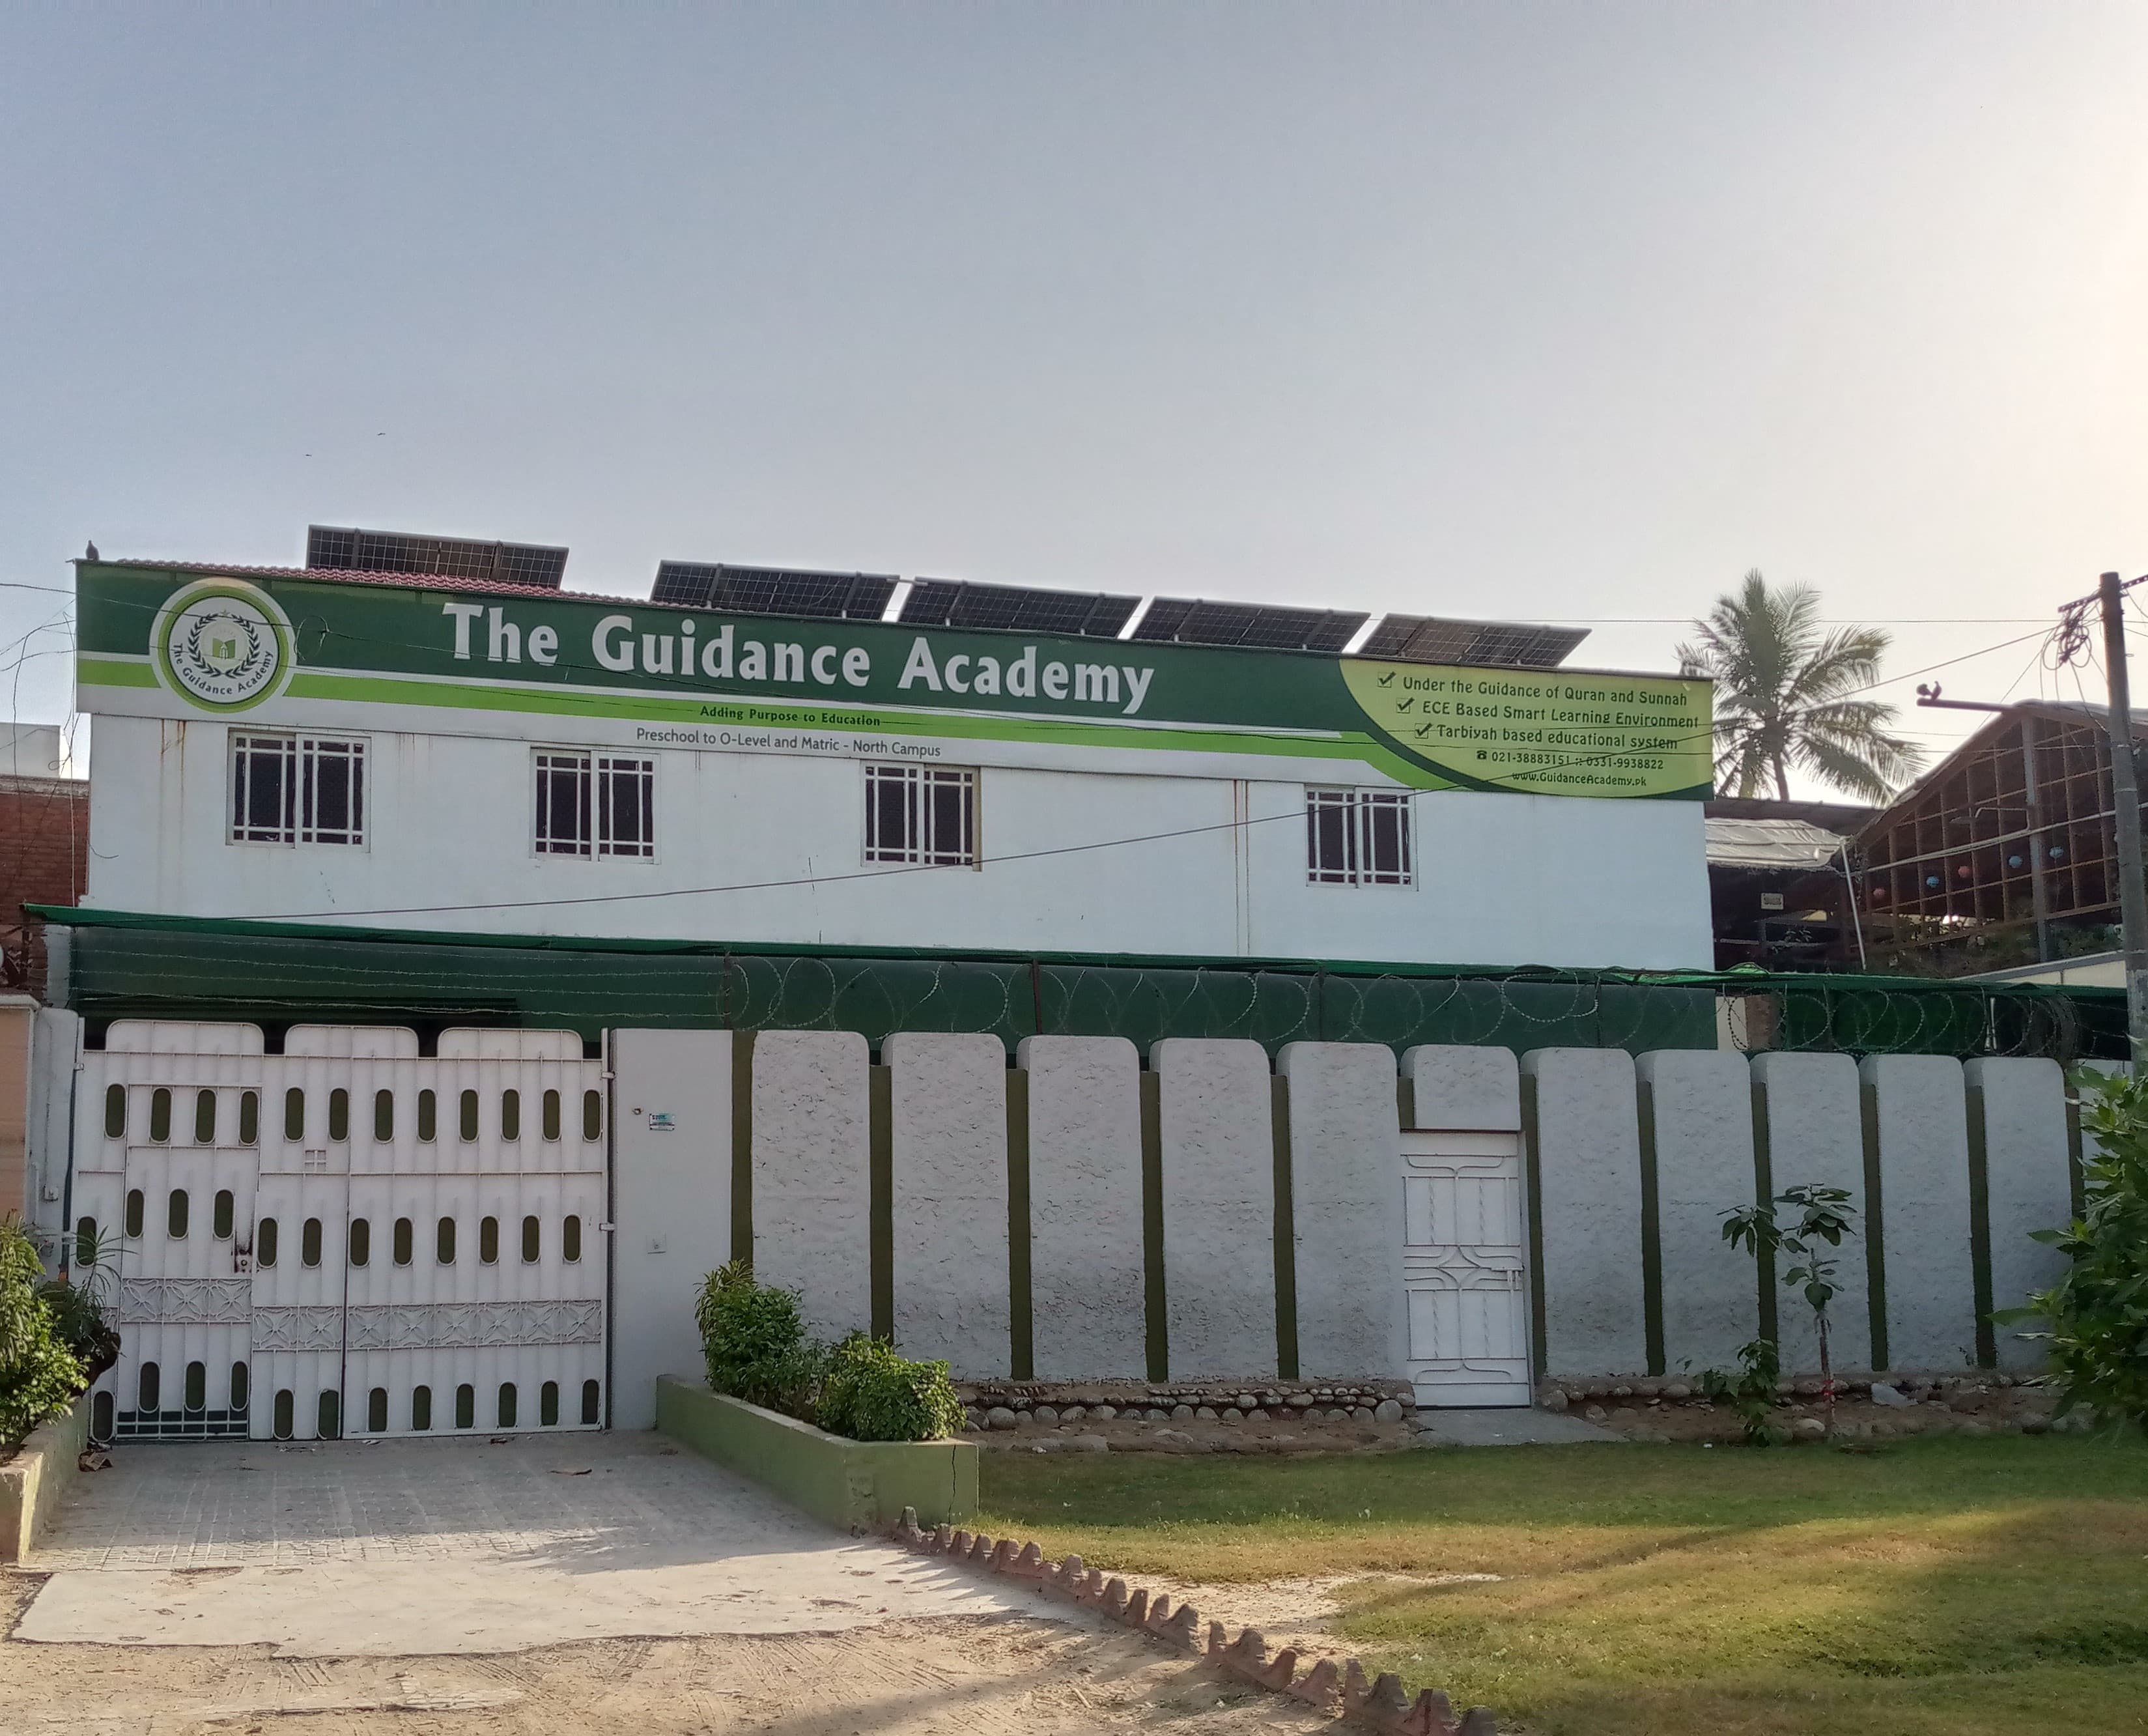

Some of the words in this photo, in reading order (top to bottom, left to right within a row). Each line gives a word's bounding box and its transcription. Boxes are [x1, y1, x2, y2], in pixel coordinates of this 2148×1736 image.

[173, 643, 183, 664] The
[182, 666, 233, 694] Guidance
[238, 651, 274, 693] Academy
[442, 602, 559, 667] The
[591, 614, 870, 687] Guidance
[898, 636, 1155, 715] Academy
[1404, 677, 1445, 692] Under
[1451, 679, 1473, 693] the
[1478, 682, 1540, 698] Guidance
[1546, 687, 1559, 698] of
[1565, 687, 1605, 702] Quran
[1611, 691, 1633, 703] and
[1639, 691, 1686, 705] Sunnah
[700, 705, 743, 720] Adding
[750, 709, 797, 723] Purpose
[804, 713, 815, 722] to
[822, 713, 880, 726] Education
[1423, 702, 1450, 715] ECE
[1456, 703, 1497, 718] Based
[1503, 706, 1545, 720] Smart
[1551, 709, 1610, 724] Learning
[1617, 713, 1698, 728] Environment
[637, 728, 699, 743] Preschool
[703, 732, 716, 744] to
[720, 732, 771, 748] O-Level
[774, 735, 797, 748] and
[802, 736, 839, 751] Matric
[853, 740, 887, 754] North
[892, 742, 940, 758] Campus
[1437, 724, 1496, 741] Tarbiyah
[1503, 728, 1542, 743] based
[1548, 731, 1625, 747] educational
[1630, 737, 1677, 750] system
[1492, 752, 1570, 765] 021-38883151
[1587, 758, 1663, 769] 0331-9938822
[1512, 772, 1646, 786] www.GuidanceAcademy.pk
